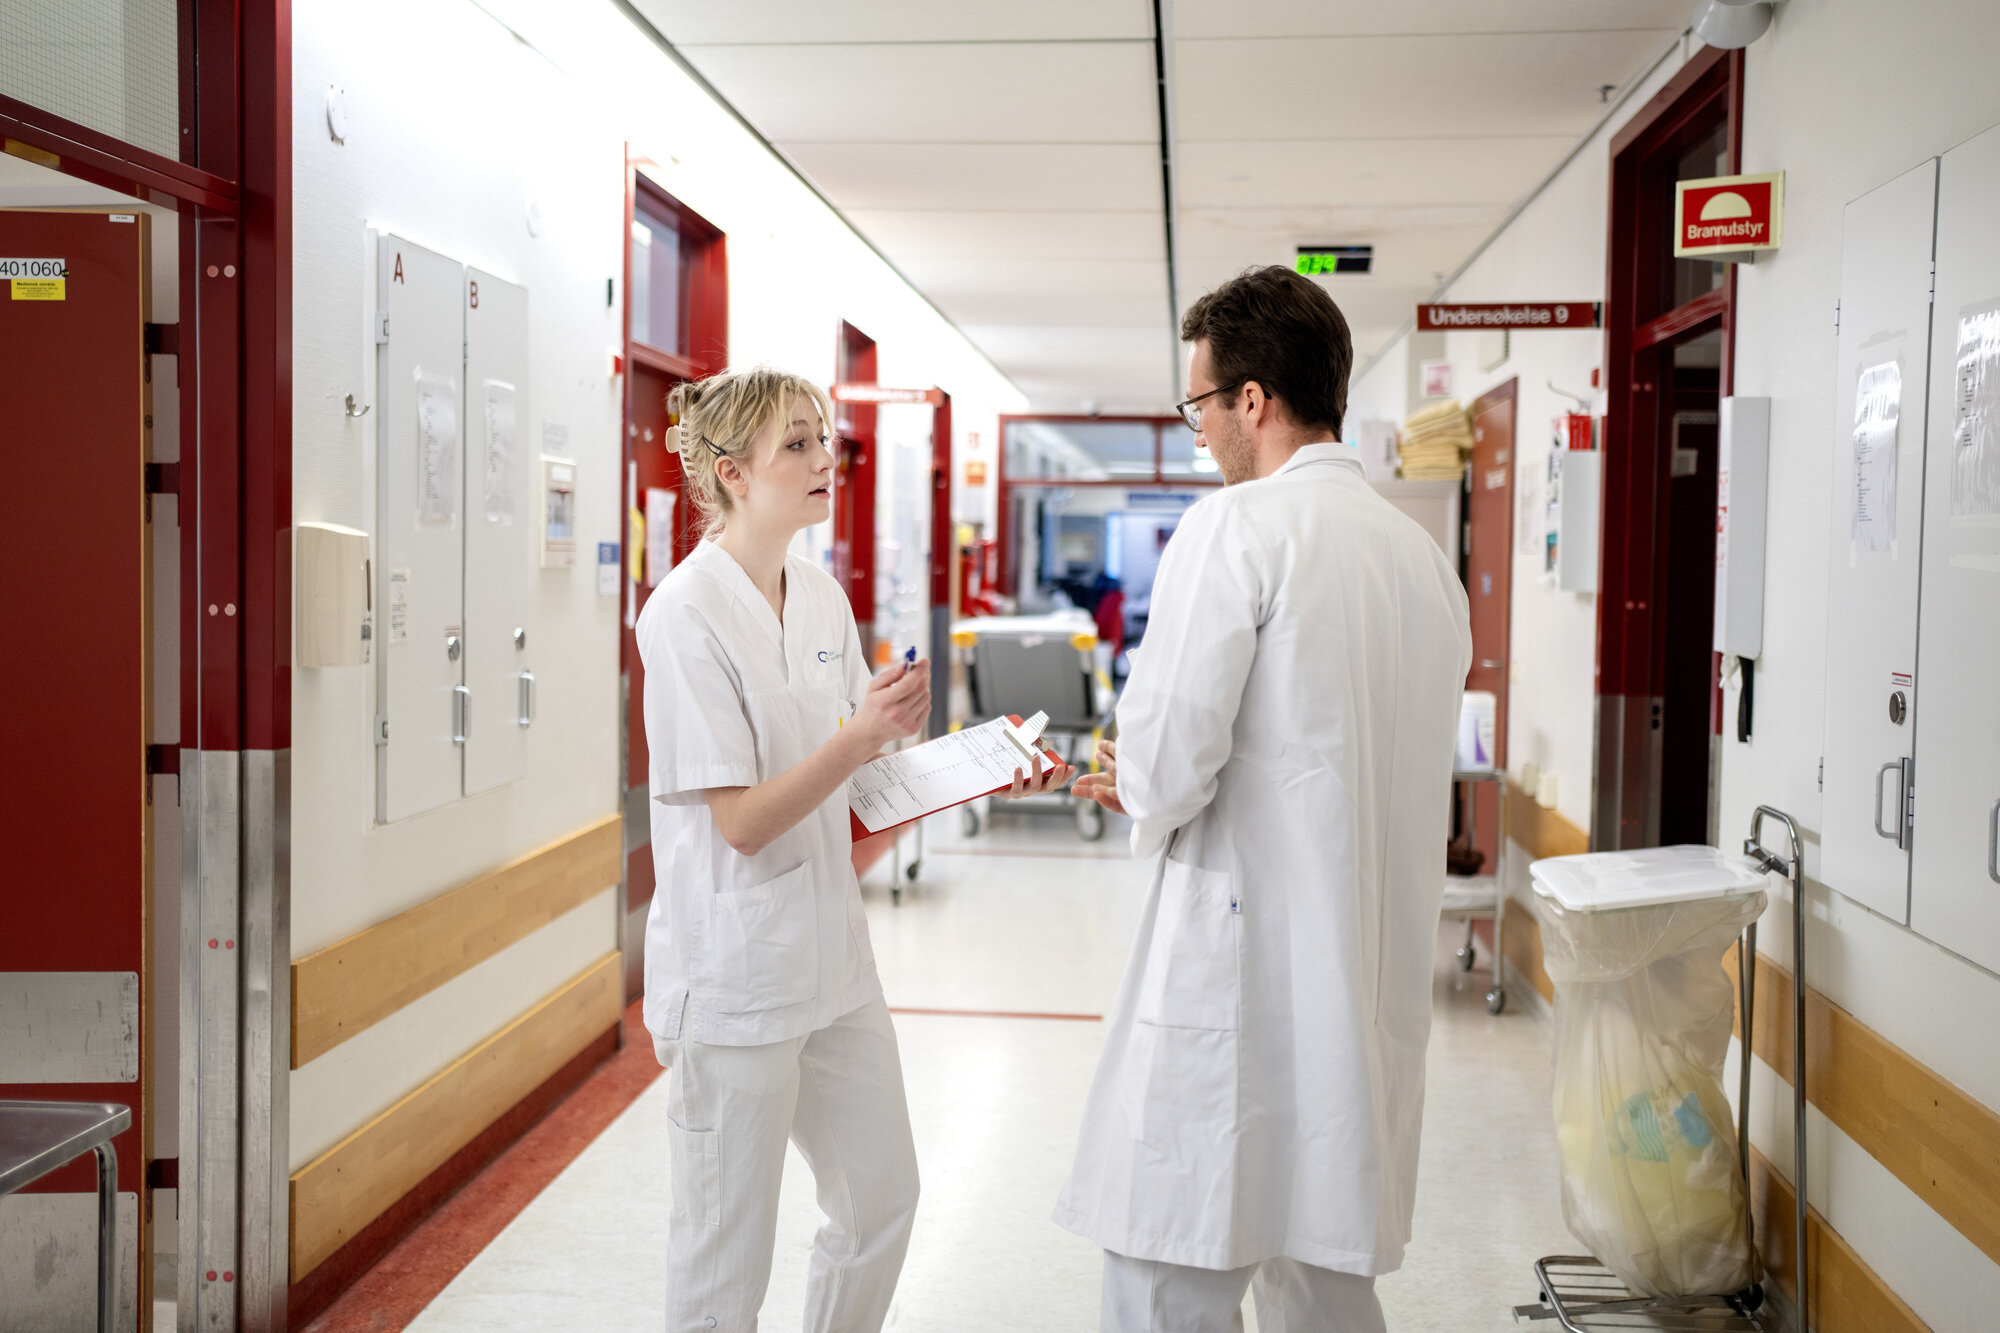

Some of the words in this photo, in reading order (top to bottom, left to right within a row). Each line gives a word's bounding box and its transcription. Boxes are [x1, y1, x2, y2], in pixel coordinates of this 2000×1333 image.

[1687, 221, 1764, 240] Brannutstyr
[393, 252, 404, 285] A
[470, 280, 479, 309] B
[1429, 306, 1551, 325] Undersøkelse
[1554, 305, 1569, 324] 9
